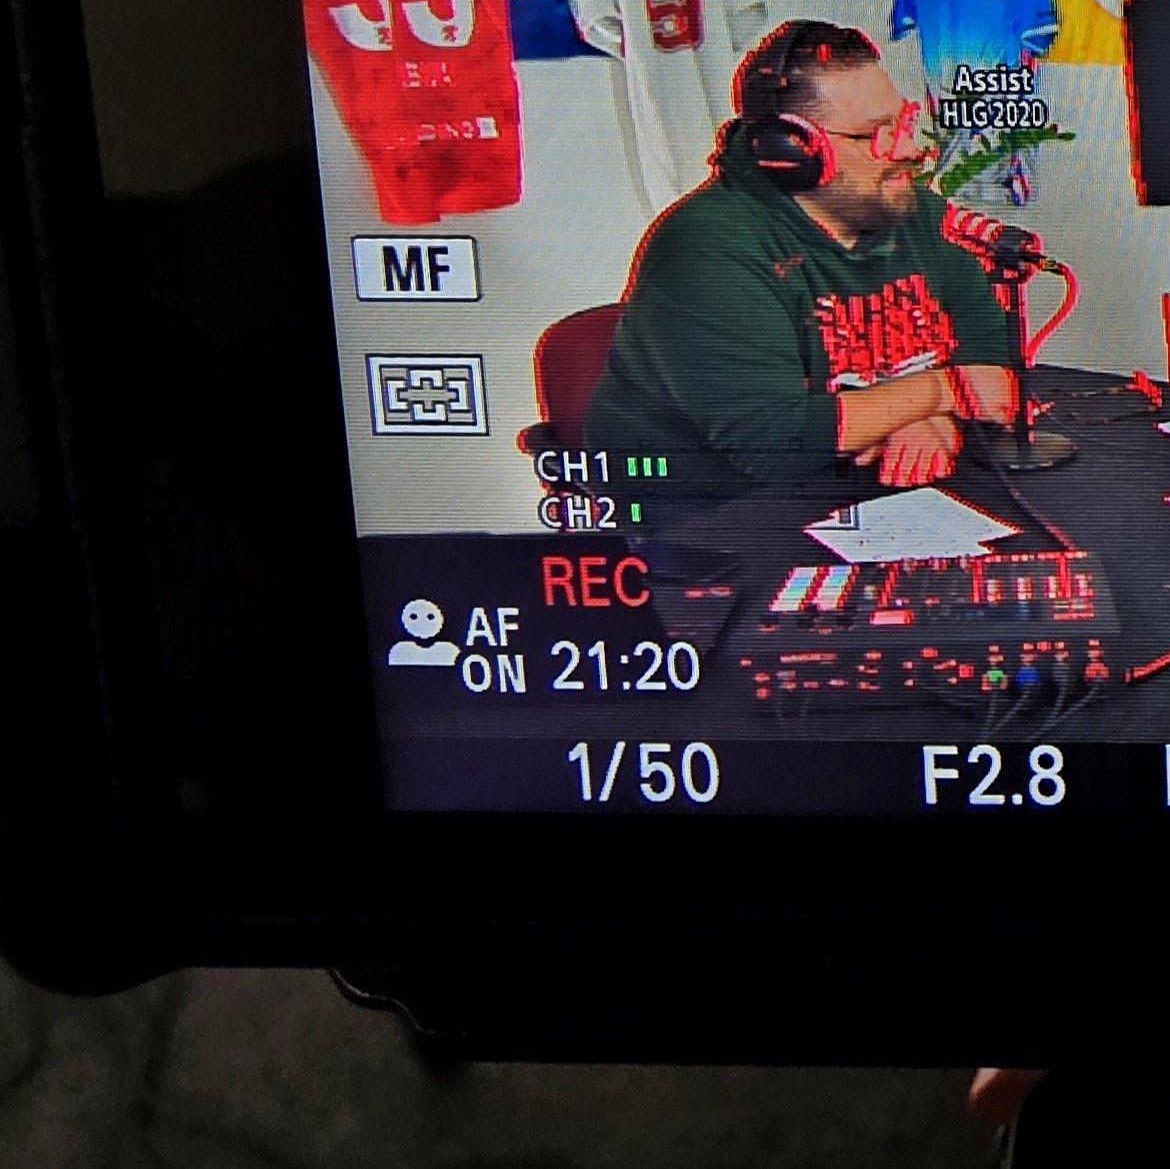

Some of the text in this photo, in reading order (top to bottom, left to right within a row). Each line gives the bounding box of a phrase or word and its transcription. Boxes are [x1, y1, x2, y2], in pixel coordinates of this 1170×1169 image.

[955, 66, 1032, 93] Assist
[942, 100, 1046, 127] HLG2020
[384, 246, 450, 292] MF
[536, 452, 610, 482] CH1
[539, 496, 616, 528] CH2
[541, 556, 650, 607] REC
[466, 607, 520, 646] AF
[462, 655, 526, 693] ON
[550, 641, 700, 691] 21:20
[567, 742, 720, 803] 1/50
[923, 745, 1066, 806] F2.8
